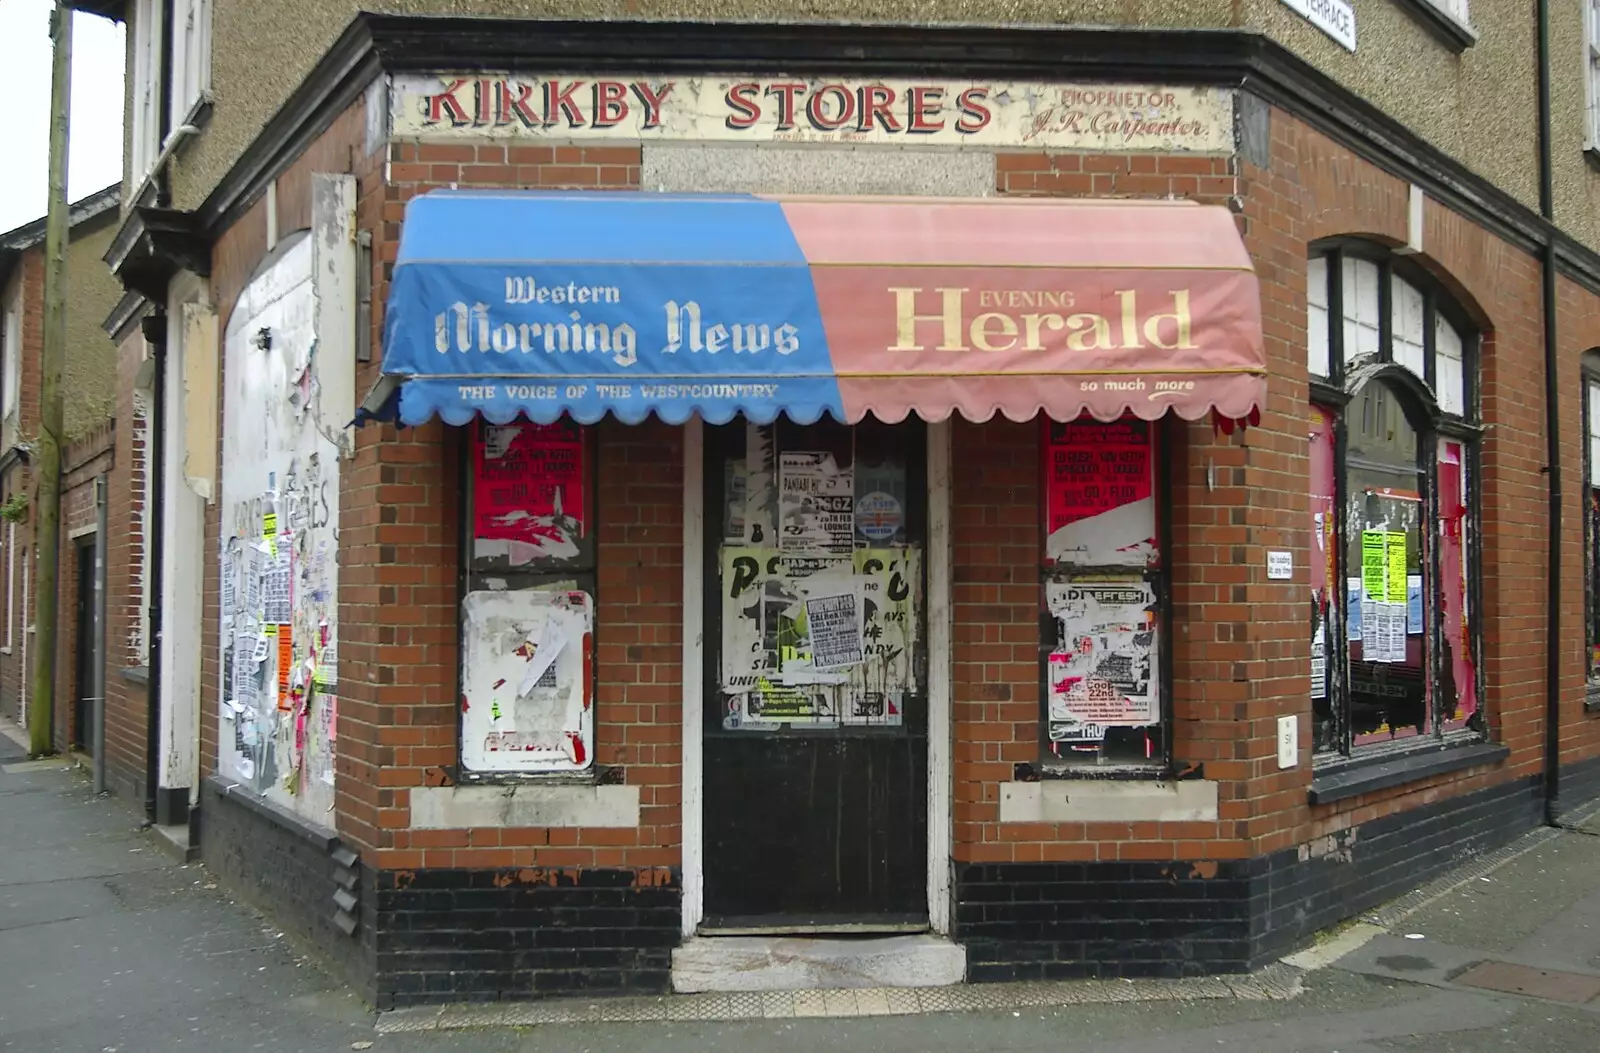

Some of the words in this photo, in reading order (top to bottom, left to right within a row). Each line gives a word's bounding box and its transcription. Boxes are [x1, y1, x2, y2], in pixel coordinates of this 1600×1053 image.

[423, 80, 676, 129] KIRKBY
[725, 83, 992, 134] STORES
[505, 276, 620, 304] Western
[980, 291, 1075, 308] EVENING
[435, 299, 637, 367] Morning
[660, 299, 800, 355] News
[887, 287, 1199, 351] Herald
[458, 385, 495, 400] THE
[505, 385, 557, 400] VOICE
[566, 385, 587, 399] OF
[596, 385, 631, 399] THE
[640, 384, 779, 399] WESTCOUNTRY
[1080, 381, 1098, 392] so
[1104, 379, 1145, 392] much
[1155, 380, 1195, 391] more
